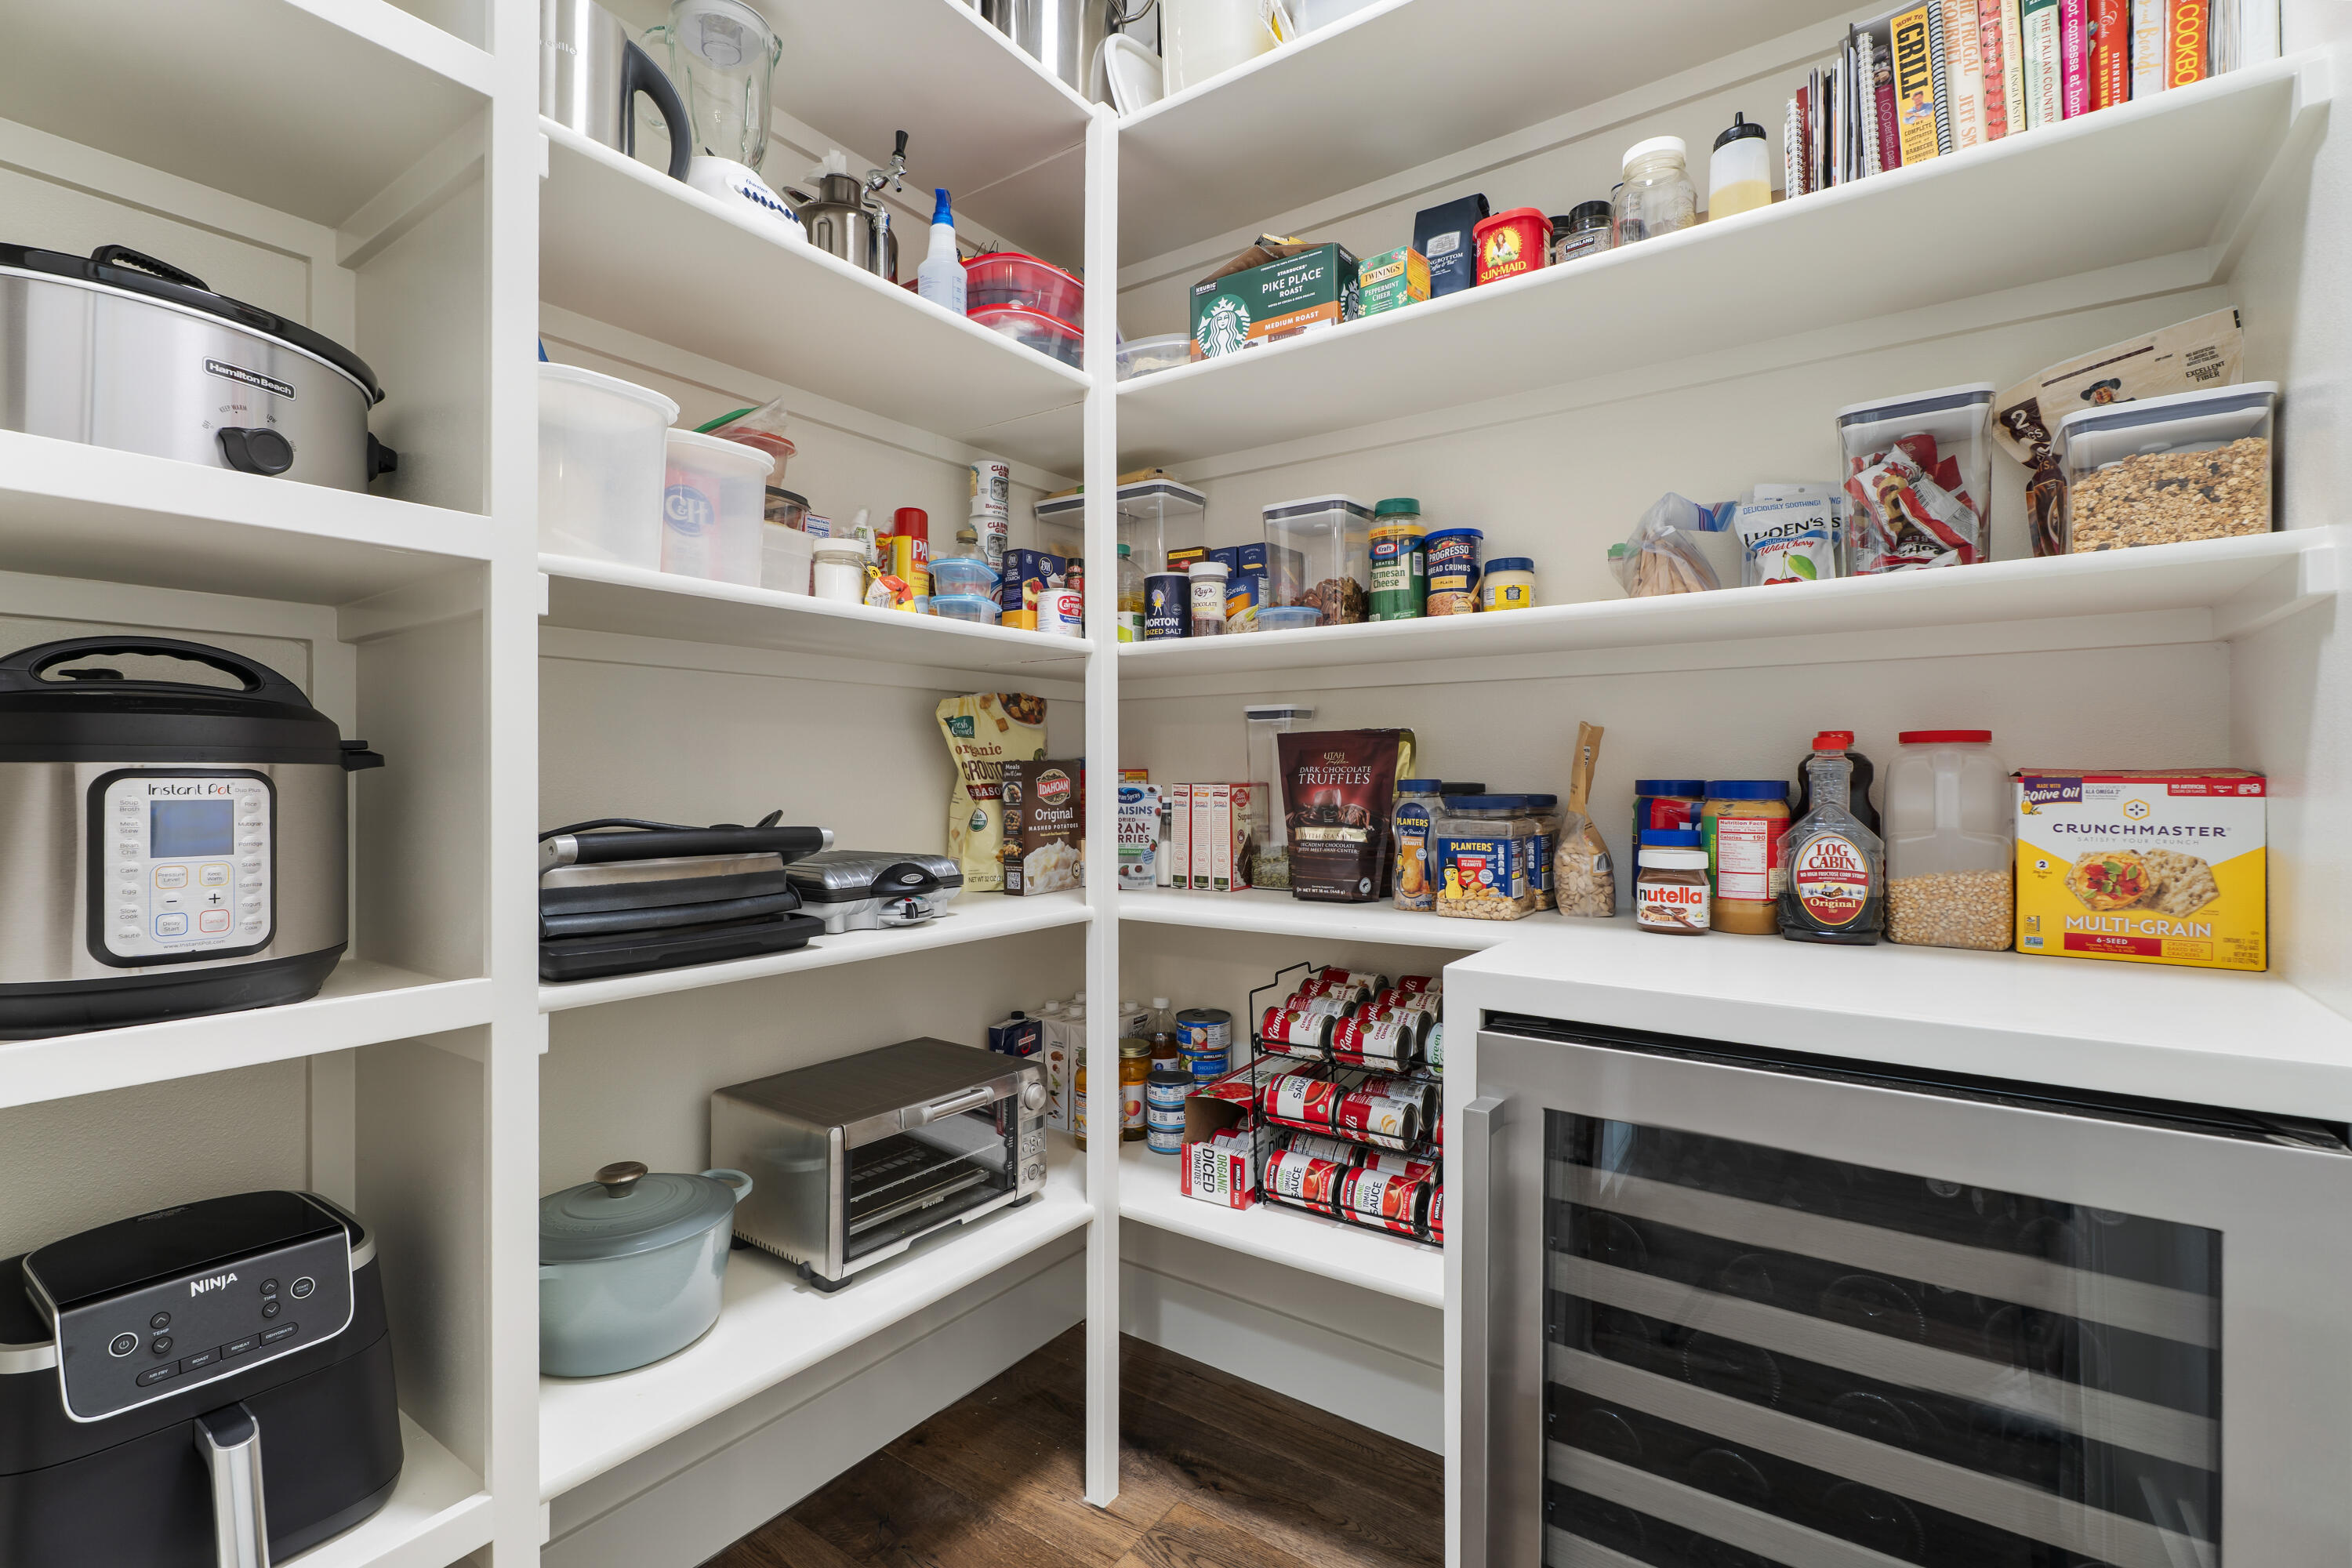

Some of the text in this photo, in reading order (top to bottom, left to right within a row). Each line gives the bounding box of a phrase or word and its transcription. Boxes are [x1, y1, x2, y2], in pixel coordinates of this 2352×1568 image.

[1895, 16, 1913, 28] HOW
[1943, 0, 1962, 65] GOURMET
[1961, 24, 1979, 75] FRUGAL
[2174, 4, 2200, 85] COOKBO
[1896, 22, 1929, 100] GRILL
[2100, 45, 2108, 66] REE
[2040, 12, 2054, 123] THE ITALIAN COUNTRY
[2067, 19, 2082, 117] contessa at hom
[1959, 94, 1976, 123] JEFF
[1882, 121, 1895, 151] perfect
[1904, 122, 1933, 136] COMPLETE
[1566, 237, 1594, 249] KIRKLAND
[1428, 252, 1464, 267] NGBOTTOM
[1364, 263, 1402, 282] TWININGS
[1481, 260, 1527, 283] SUN-MAID
[1196, 282, 1217, 293] KEURIG
[1262, 267, 1324, 294] PIKE PLACE
[1279, 285, 1303, 298] ROAST
[1364, 281, 1399, 297] PEPPERMINT
[1372, 290, 1391, 301] CHEER
[1265, 310, 1319, 331] MEDIUM ROAST
[2186, 361, 2226, 378] EXCELLENT
[209, 363, 292, 394] Hamilton Beach
[2196, 372, 2220, 383] FIBER
[267, 413, 277, 423] LOW
[2011, 409, 2031, 430] 2
[1743, 503, 1784, 515] DELICIOUSLY
[1785, 499, 1821, 509] SOOTHING!
[1743, 517, 1824, 549] LUDEN'S
[1428, 545, 1469, 563] PROGRESSO
[1757, 539, 1815, 557] Wild Cherry
[1370, 570, 1406, 581] Parmesan
[1428, 564, 1471, 575] BREAD CRUMBS
[1373, 579, 1399, 589] Cheese
[1194, 587, 1214, 597] Ray's
[1145, 618, 1179, 626] MORTON
[955, 742, 1003, 757] organic
[961, 760, 1004, 781] CROUTO
[1298, 773, 1371, 785] TRUFFLES
[148, 783, 232, 796] Instant Pot
[1039, 780, 1069, 795] IDAHOAN
[2030, 787, 2081, 801] Olive Oil
[1127, 792, 1141, 801] Spray
[1035, 808, 1073, 822] Original
[1118, 806, 1152, 815] AISINS
[1397, 817, 1428, 827] PLANTERS
[2053, 823, 2227, 837] CRUNCHMASTER
[1450, 842, 1493, 852] PLANTERS
[1816, 844, 1848, 856] LOG
[1809, 856, 1857, 870] CABIN
[1639, 887, 1702, 904] nutella
[1810, 898, 1857, 909] Original
[2066, 916, 2212, 938] MULTI-GRAIN
[163, 939, 226, 949] www.InstantPot.com
[1432, 1034, 1442, 1065] Green
[1203, 1148, 1215, 1193] DICED
[1217, 1154, 1228, 1194] ORGANIC
[1291, 1166, 1302, 1198] SAUCE
[1346, 1180, 1355, 1206] KIRKLAND
[1356, 1182, 1365, 1208] ORGANIC
[1363, 1185, 1371, 1208] TOMATO
[1370, 1181, 1383, 1217] SAUCE
[1435, 1192, 1443, 1221] KIRKLAND
[190, 1272, 238, 1298] NINJA
[263, 1294, 277, 1302] TIME
[152, 1327, 169, 1337] TEMP
[265, 1327, 293, 1340] DEHYDRATE
[231, 1341, 251, 1352] REHEAT
[191, 1355, 209, 1365] ROAST
